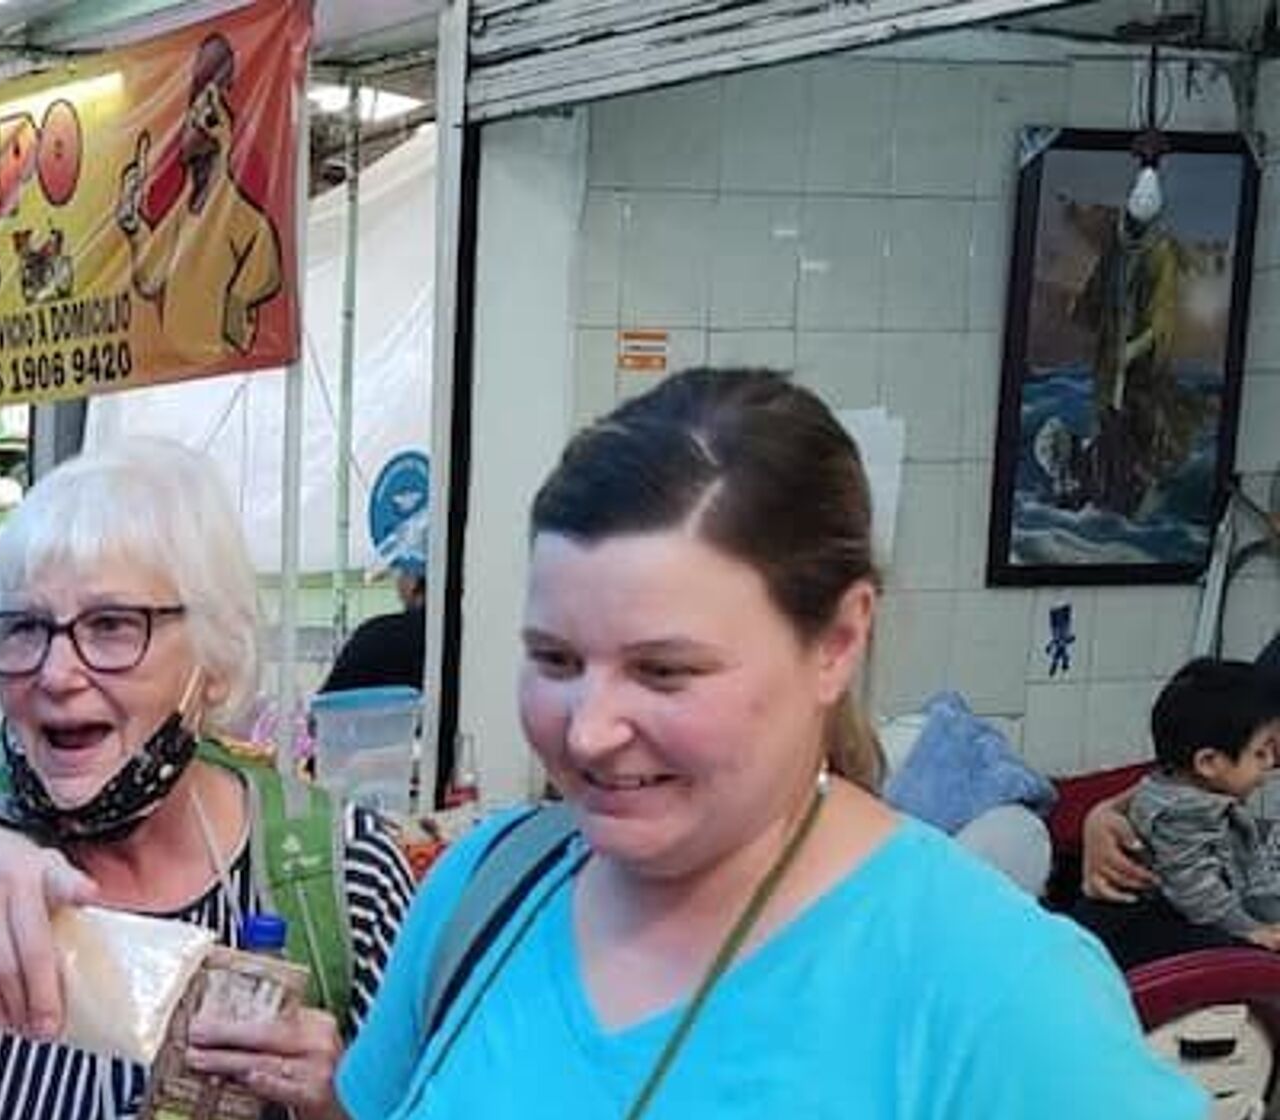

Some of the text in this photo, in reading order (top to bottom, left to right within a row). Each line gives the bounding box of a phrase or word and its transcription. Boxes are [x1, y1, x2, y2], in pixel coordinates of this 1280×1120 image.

[38, 311, 50, 343] A
[51, 291, 132, 342] DOMICILIO
[10, 350, 66, 394] 1906
[72, 341, 134, 386] 9420
